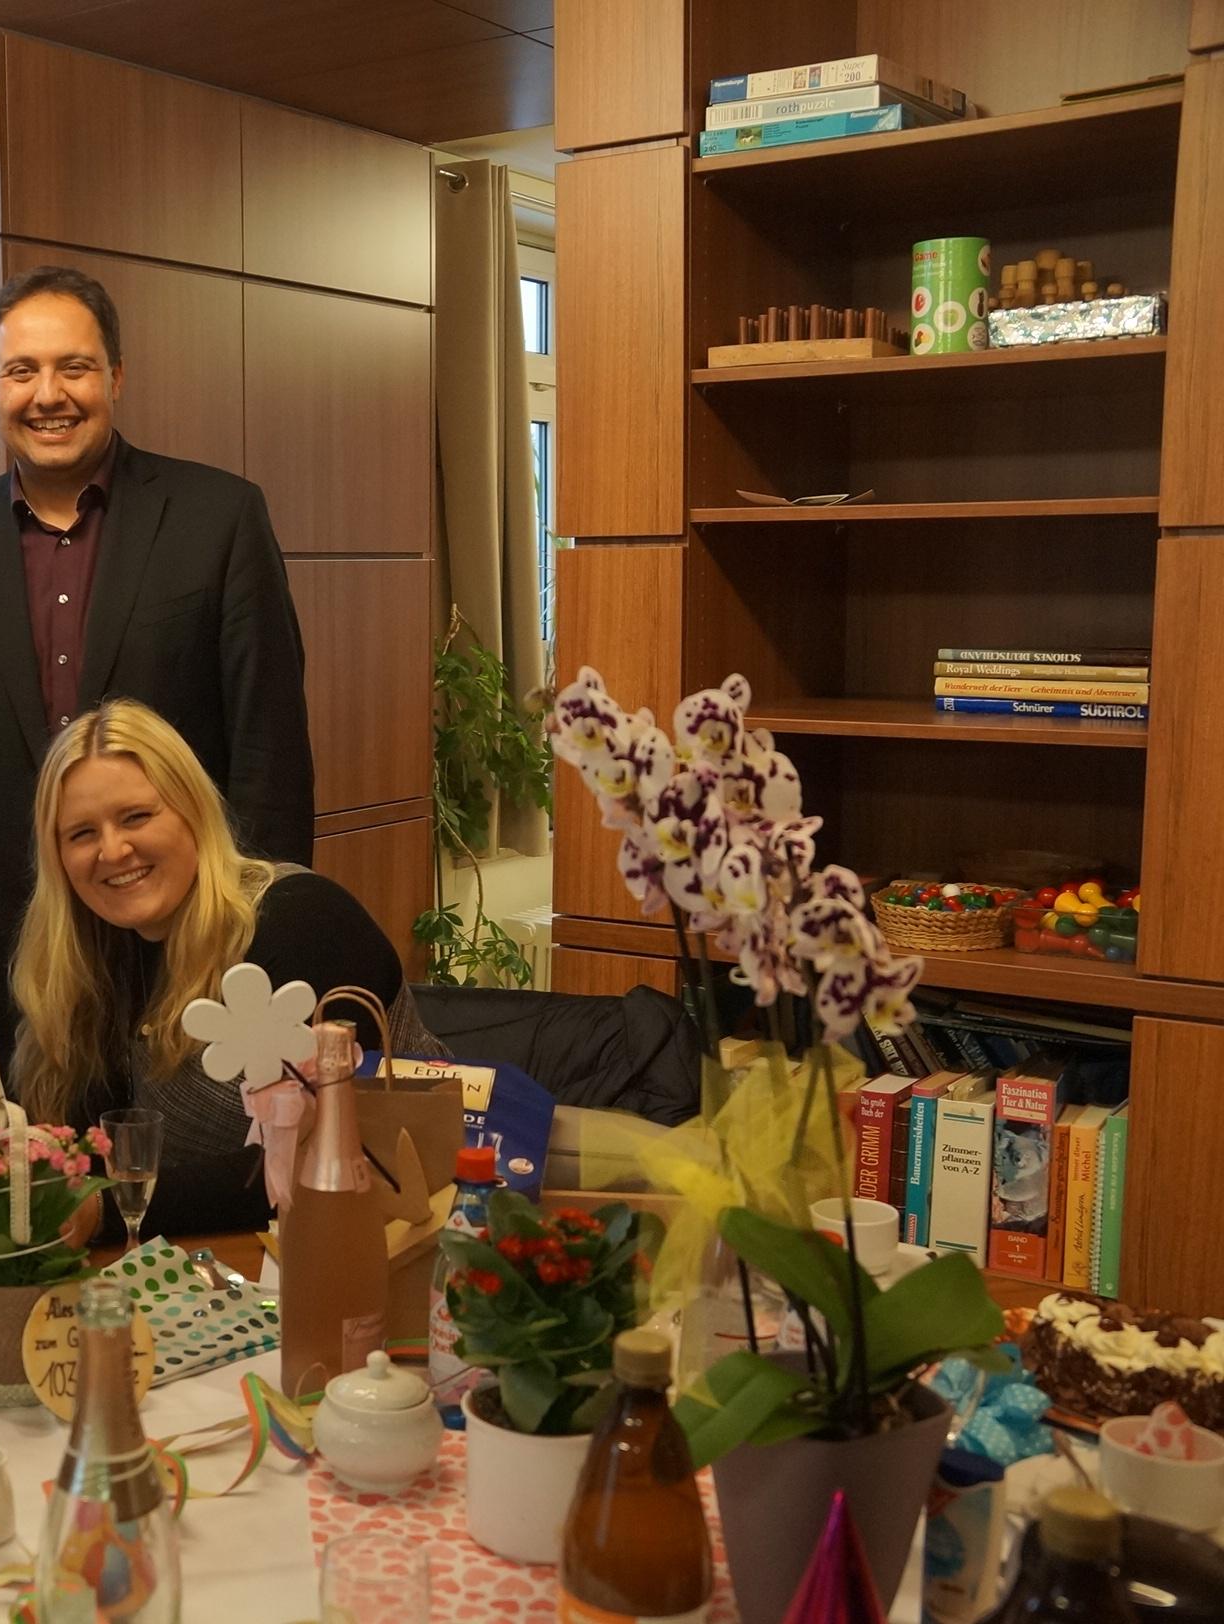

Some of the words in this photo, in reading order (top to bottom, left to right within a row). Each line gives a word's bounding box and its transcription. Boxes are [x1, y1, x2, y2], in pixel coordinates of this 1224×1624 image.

[841, 60, 866, 72] Super
[844, 72, 862, 82] 200
[775, 97, 836, 115] rothpuzzle
[960, 651, 1030, 661] DEUTSCHLAND
[946, 663, 973, 675] Royal
[976, 664, 1021, 677] Weddings
[944, 682, 988, 691] Wunderwelt
[989, 683, 1003, 692] der
[1030, 686, 1074, 695] Geheimnis
[1075, 687, 1092, 696] und
[1094, 688, 1137, 697] Abenteuer
[1012, 702, 1055, 713] Schnürer
[1080, 704, 1145, 718] SÜDTIROL
[1002, 1083, 1048, 1100] Faszination
[860, 1096, 870, 1105] Das
[1001, 1095, 1017, 1107] Tier
[1017, 1098, 1024, 1109] &
[1025, 1098, 1048, 1111] Natur
[861, 1107, 874, 1117] Buch
[874, 1108, 885, 1118] der
[860, 1124, 881, 1167] GRIMM
[910, 1102, 925, 1185] Bauernweisheiten
[942, 1143, 982, 1156] Zimmer-
[941, 1153, 981, 1166] pflanzen
[1081, 1150, 1091, 1182] Michel
[961, 1166, 980, 1175] A-Z
[855, 1170, 878, 1200] ÜDER
[1007, 1235, 1028, 1244] BAND
[1072, 1228, 1083, 1252] Astrid
[34, 1339, 58, 1351] zum
